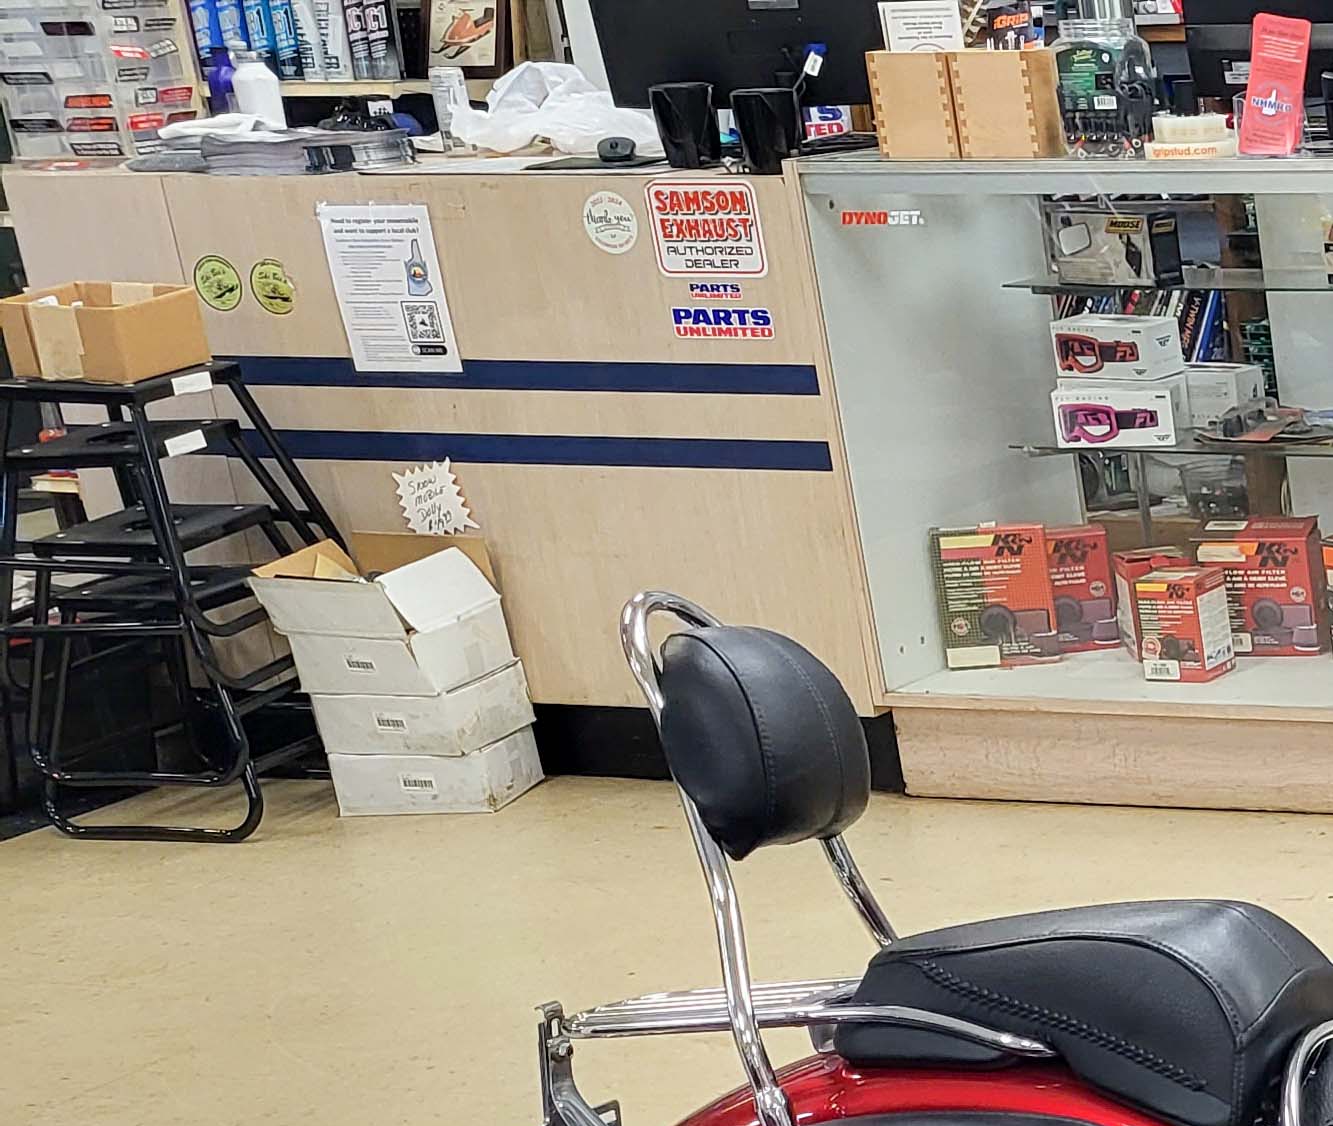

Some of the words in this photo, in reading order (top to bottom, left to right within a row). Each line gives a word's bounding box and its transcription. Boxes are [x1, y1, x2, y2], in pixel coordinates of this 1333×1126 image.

[654, 190, 750, 216] SAMSON
[841, 210, 921, 225] DYNOJET
[1108, 218, 1143, 231] MOOSE
[660, 217, 754, 242] EXHAUST
[666, 245, 754, 256] AUTHORIZED
[685, 259, 740, 269] DEALER
[689, 283, 741, 293] PARTS
[672, 307, 771, 326] PARTS
[675, 326, 773, 338] UNLIMITED
[991, 533, 1033, 557] K&N
[1256, 542, 1299, 567] K&N
[1167, 583, 1190, 599] K&N
